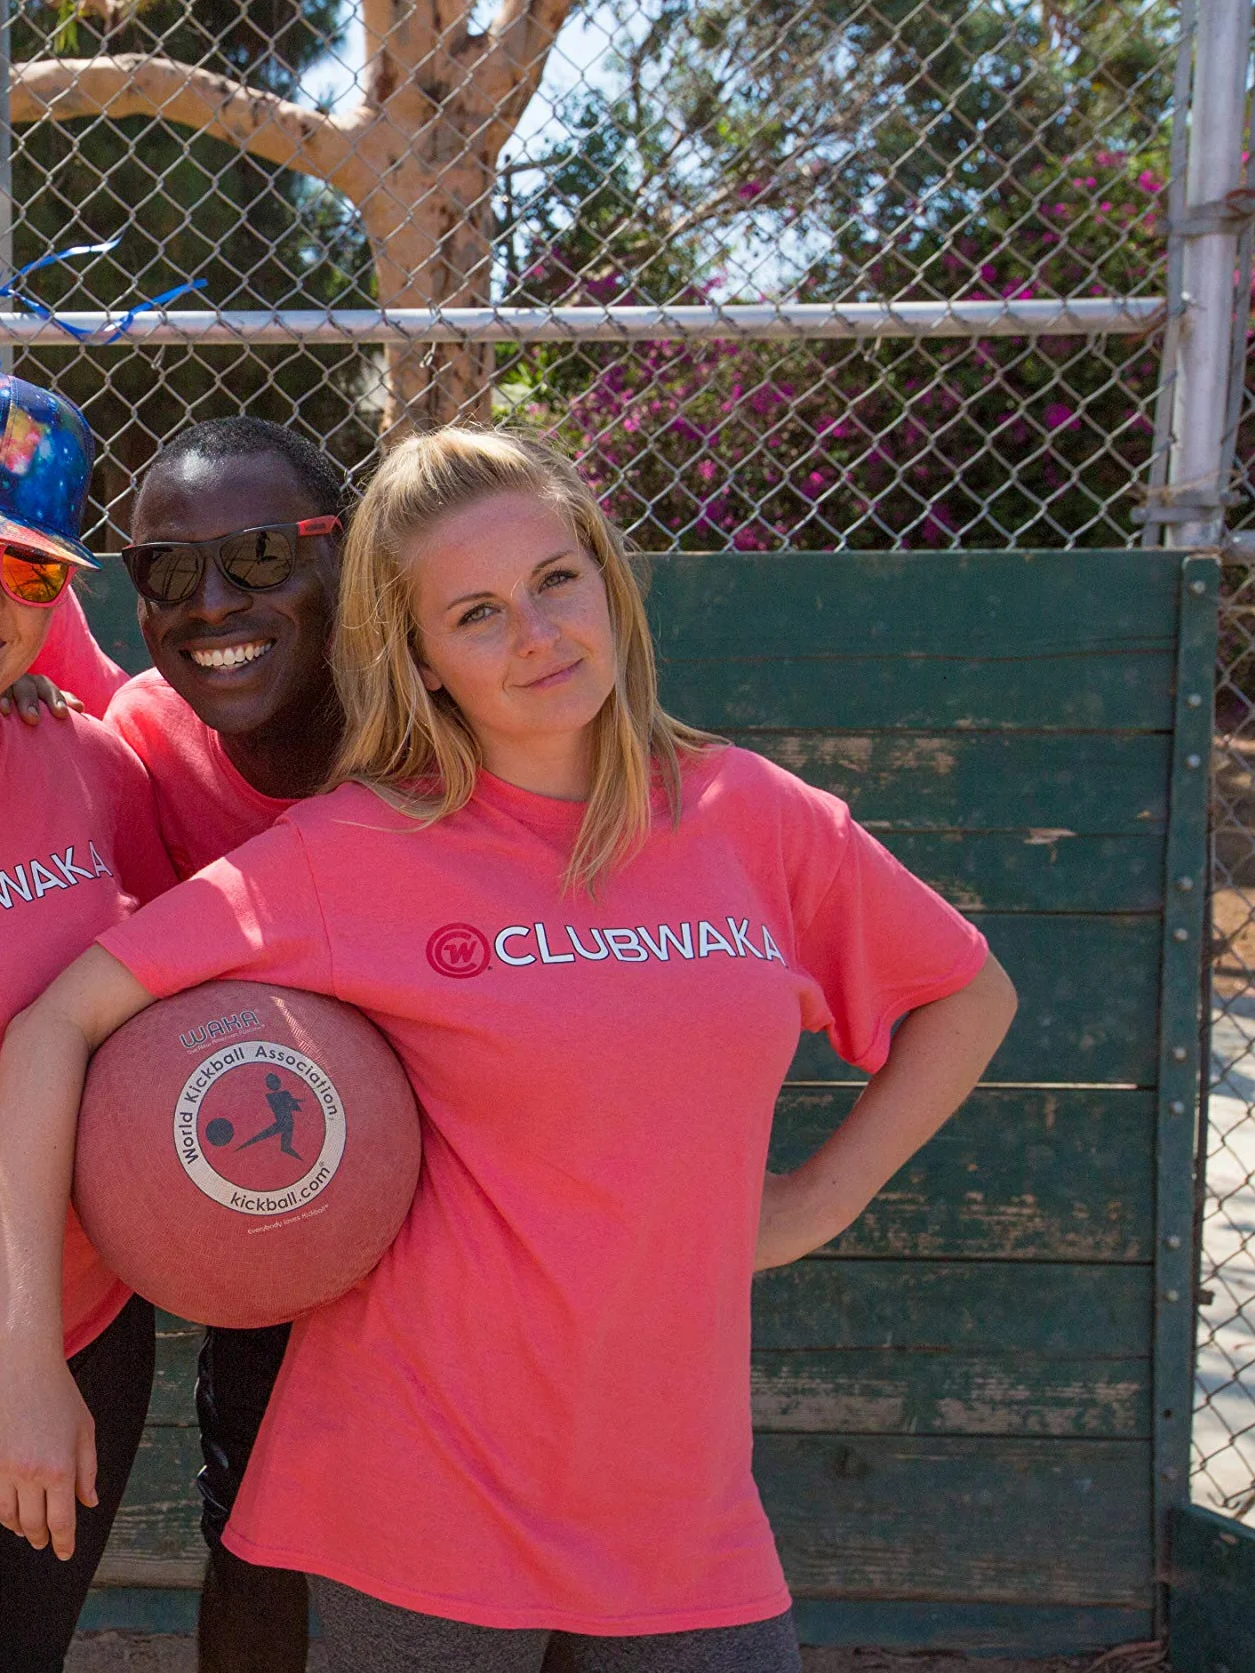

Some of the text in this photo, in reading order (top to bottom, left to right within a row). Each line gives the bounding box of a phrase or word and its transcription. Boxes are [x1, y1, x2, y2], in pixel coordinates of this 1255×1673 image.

[494, 916, 789, 969] CLUBWAKA
[179, 1010, 260, 1049] WAKA
[178, 1045, 338, 1165] World Kickball Association
[230, 1166, 331, 1212] kickball.com
